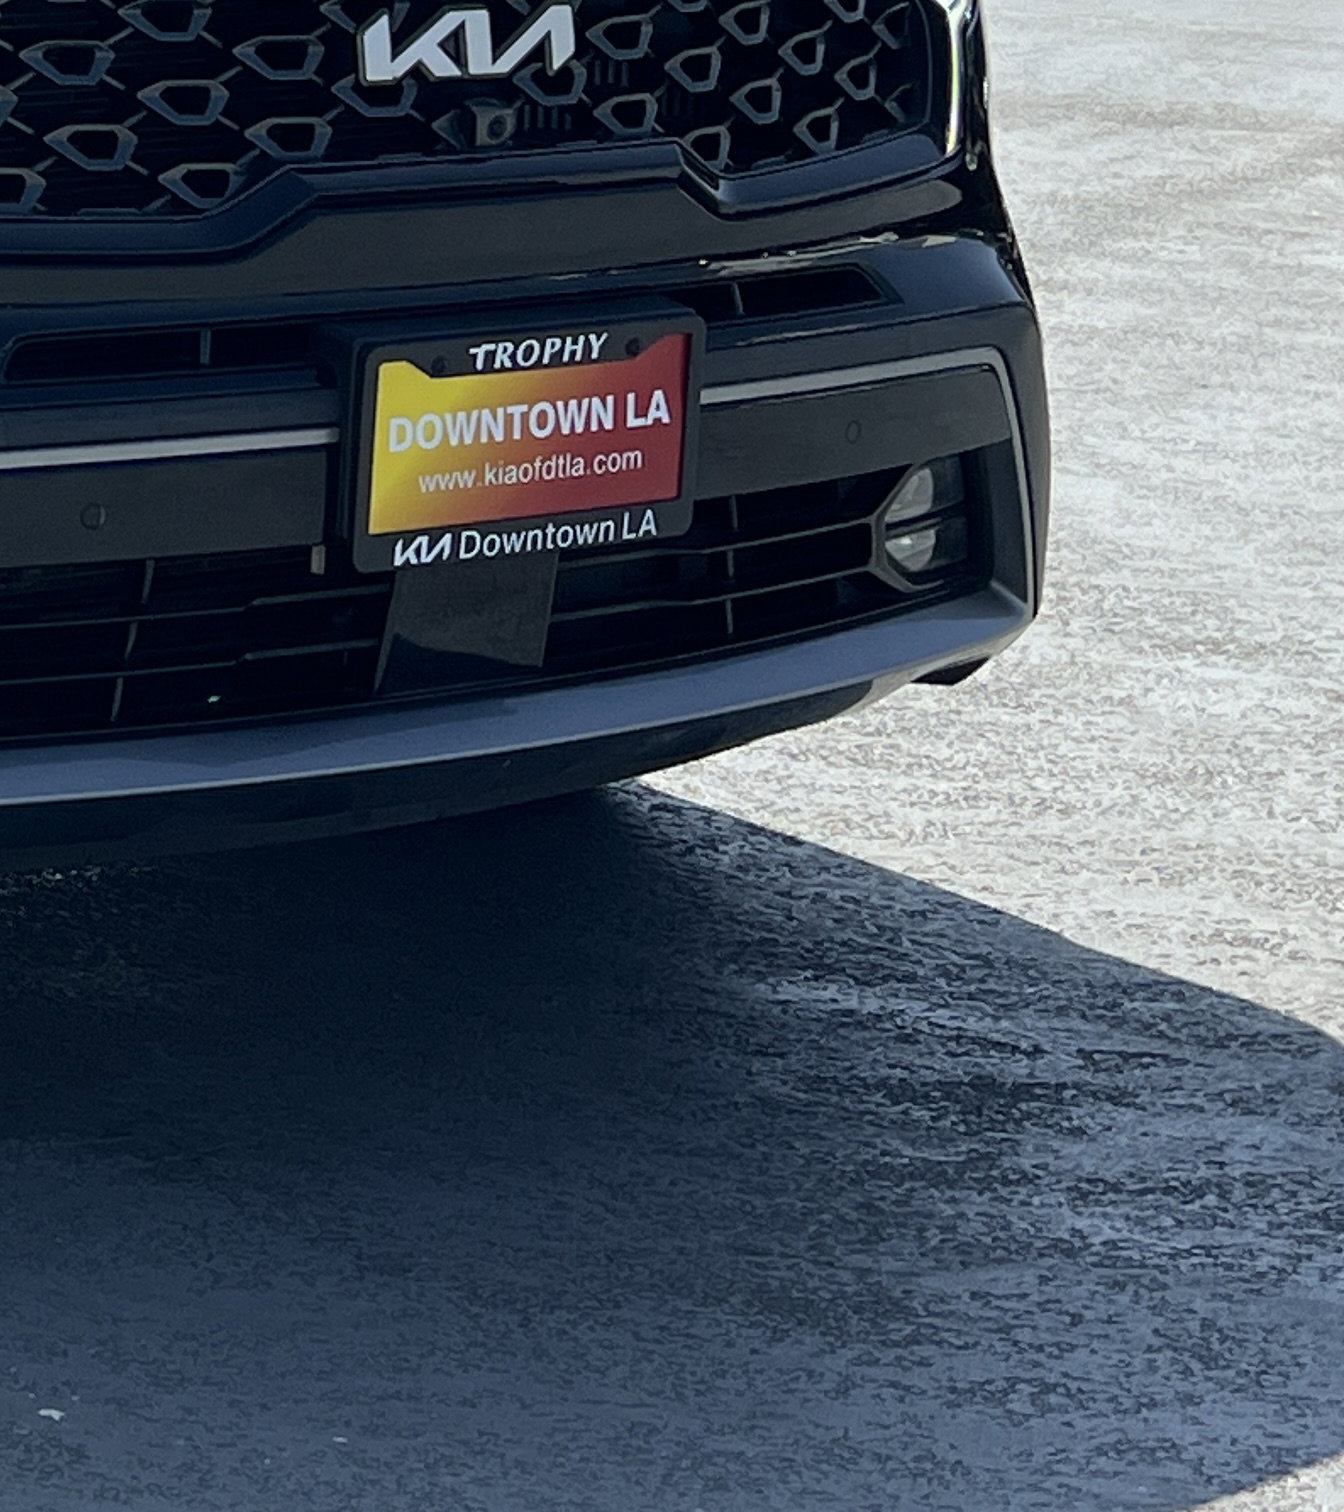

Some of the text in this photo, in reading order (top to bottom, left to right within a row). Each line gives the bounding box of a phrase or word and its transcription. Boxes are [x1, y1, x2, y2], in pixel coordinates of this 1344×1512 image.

[361, 3, 576, 83] KIA
[469, 332, 609, 371] TROPHY
[388, 389, 670, 453] DOWNTOWN LA
[418, 449, 643, 493] www.kiaofdtla.com
[393, 508, 659, 567] KIA Downtown LA
